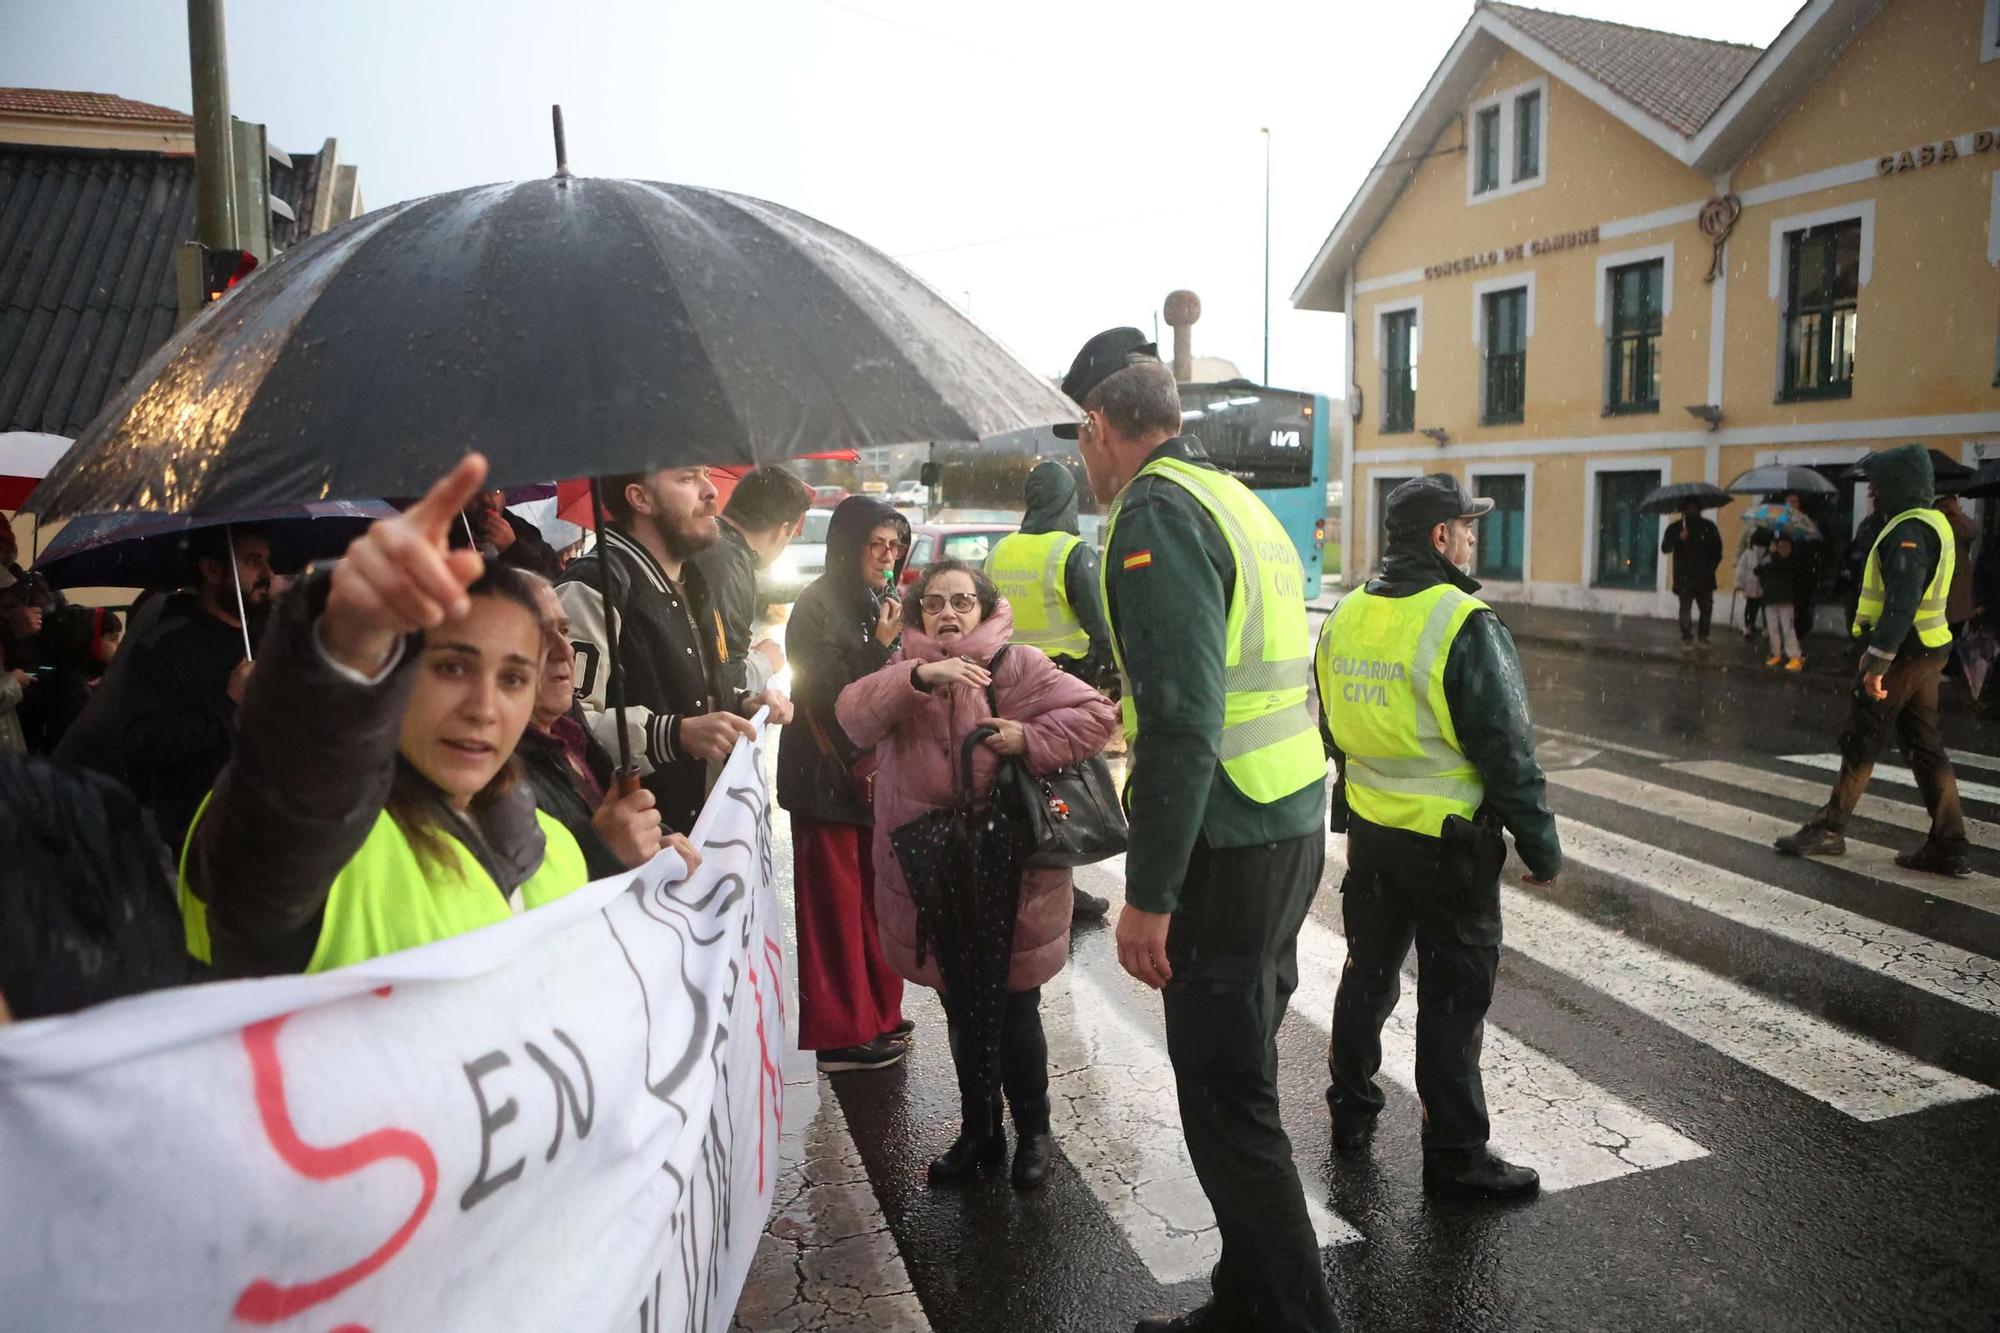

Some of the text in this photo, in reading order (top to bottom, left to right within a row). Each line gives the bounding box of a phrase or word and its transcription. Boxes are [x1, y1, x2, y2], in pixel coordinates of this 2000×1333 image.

[1876, 139, 1958, 177] CASA
[1424, 225, 1600, 280] CONCELLO DE CAMBRE
[1332, 655, 1407, 681] GUARDIA
[1343, 683, 1389, 707] CIVIL
